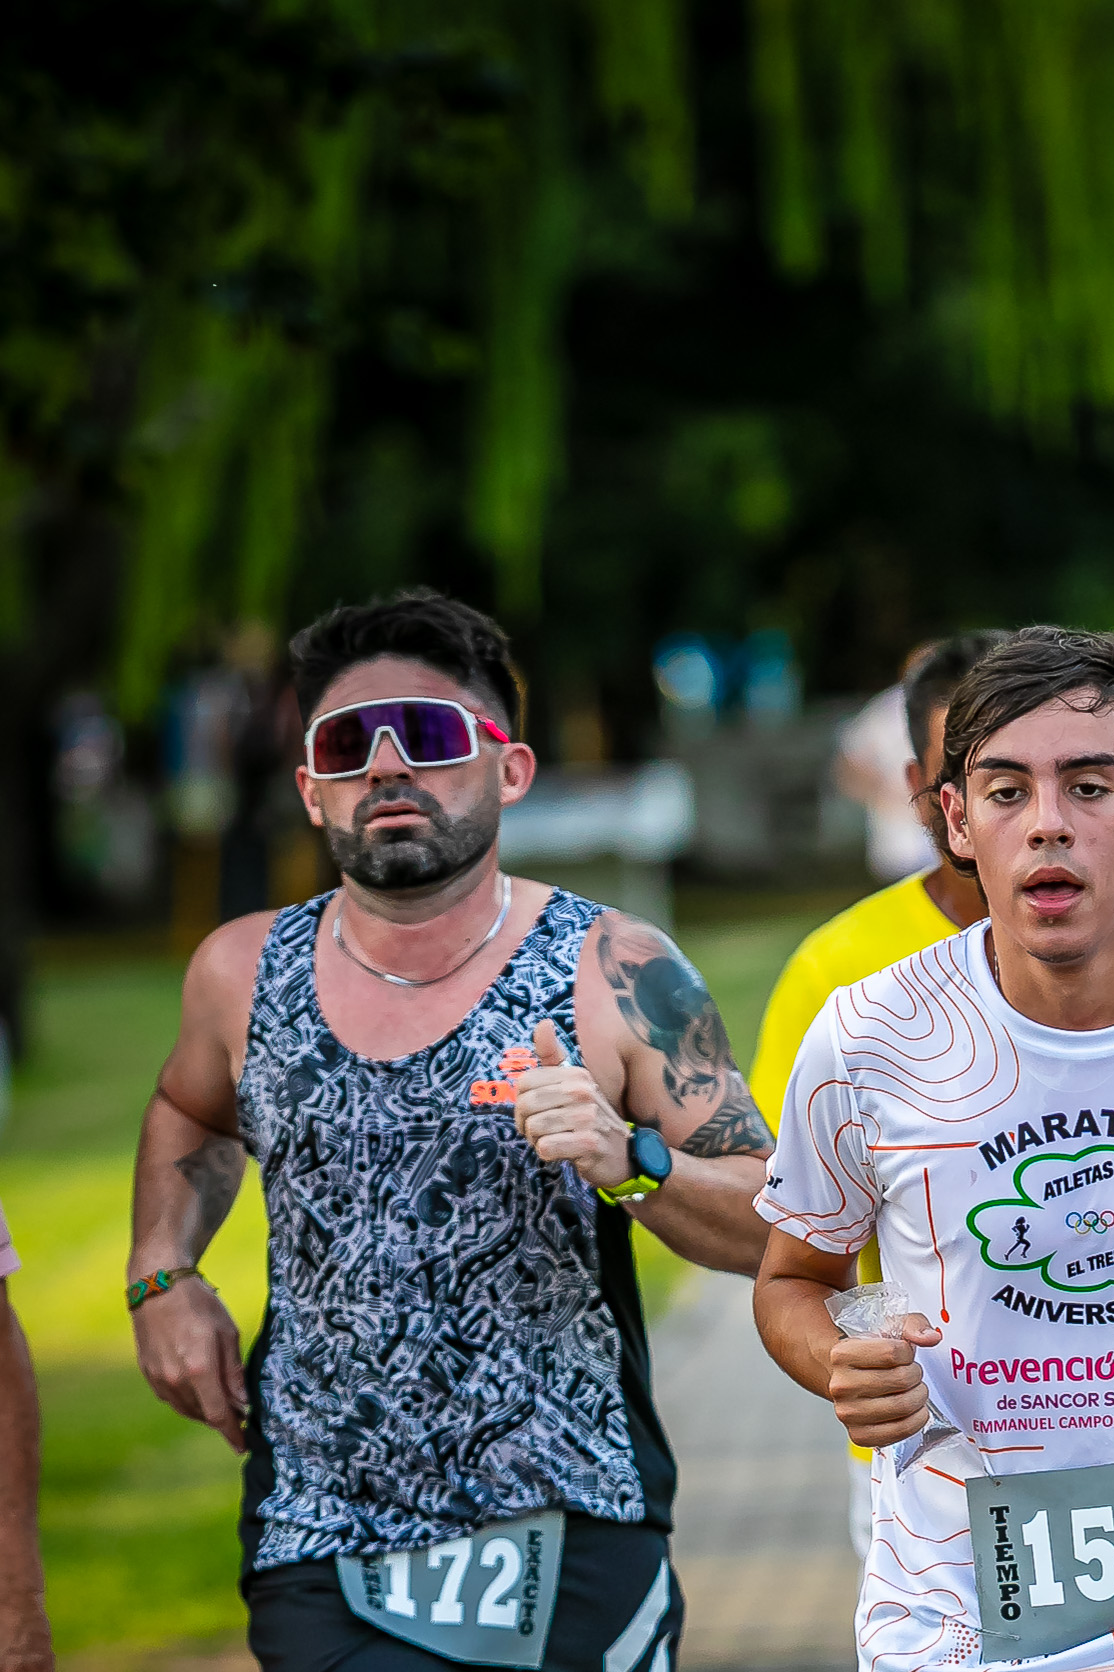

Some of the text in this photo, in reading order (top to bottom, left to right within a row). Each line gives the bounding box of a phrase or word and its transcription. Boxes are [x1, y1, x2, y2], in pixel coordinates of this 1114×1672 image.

[1044, 1160, 1114, 1201] ATLETAS
[1066, 1260, 1085, 1278] EL
[997, 1392, 1017, 1411] de
[1021, 1392, 1099, 1411] SANCOR
[973, 1417, 1055, 1434] EMMANUEL
[384, 1536, 523, 1630] 172
[518, 1529, 544, 1636] EXACTO
[989, 1505, 1021, 1621] TIEMPO
